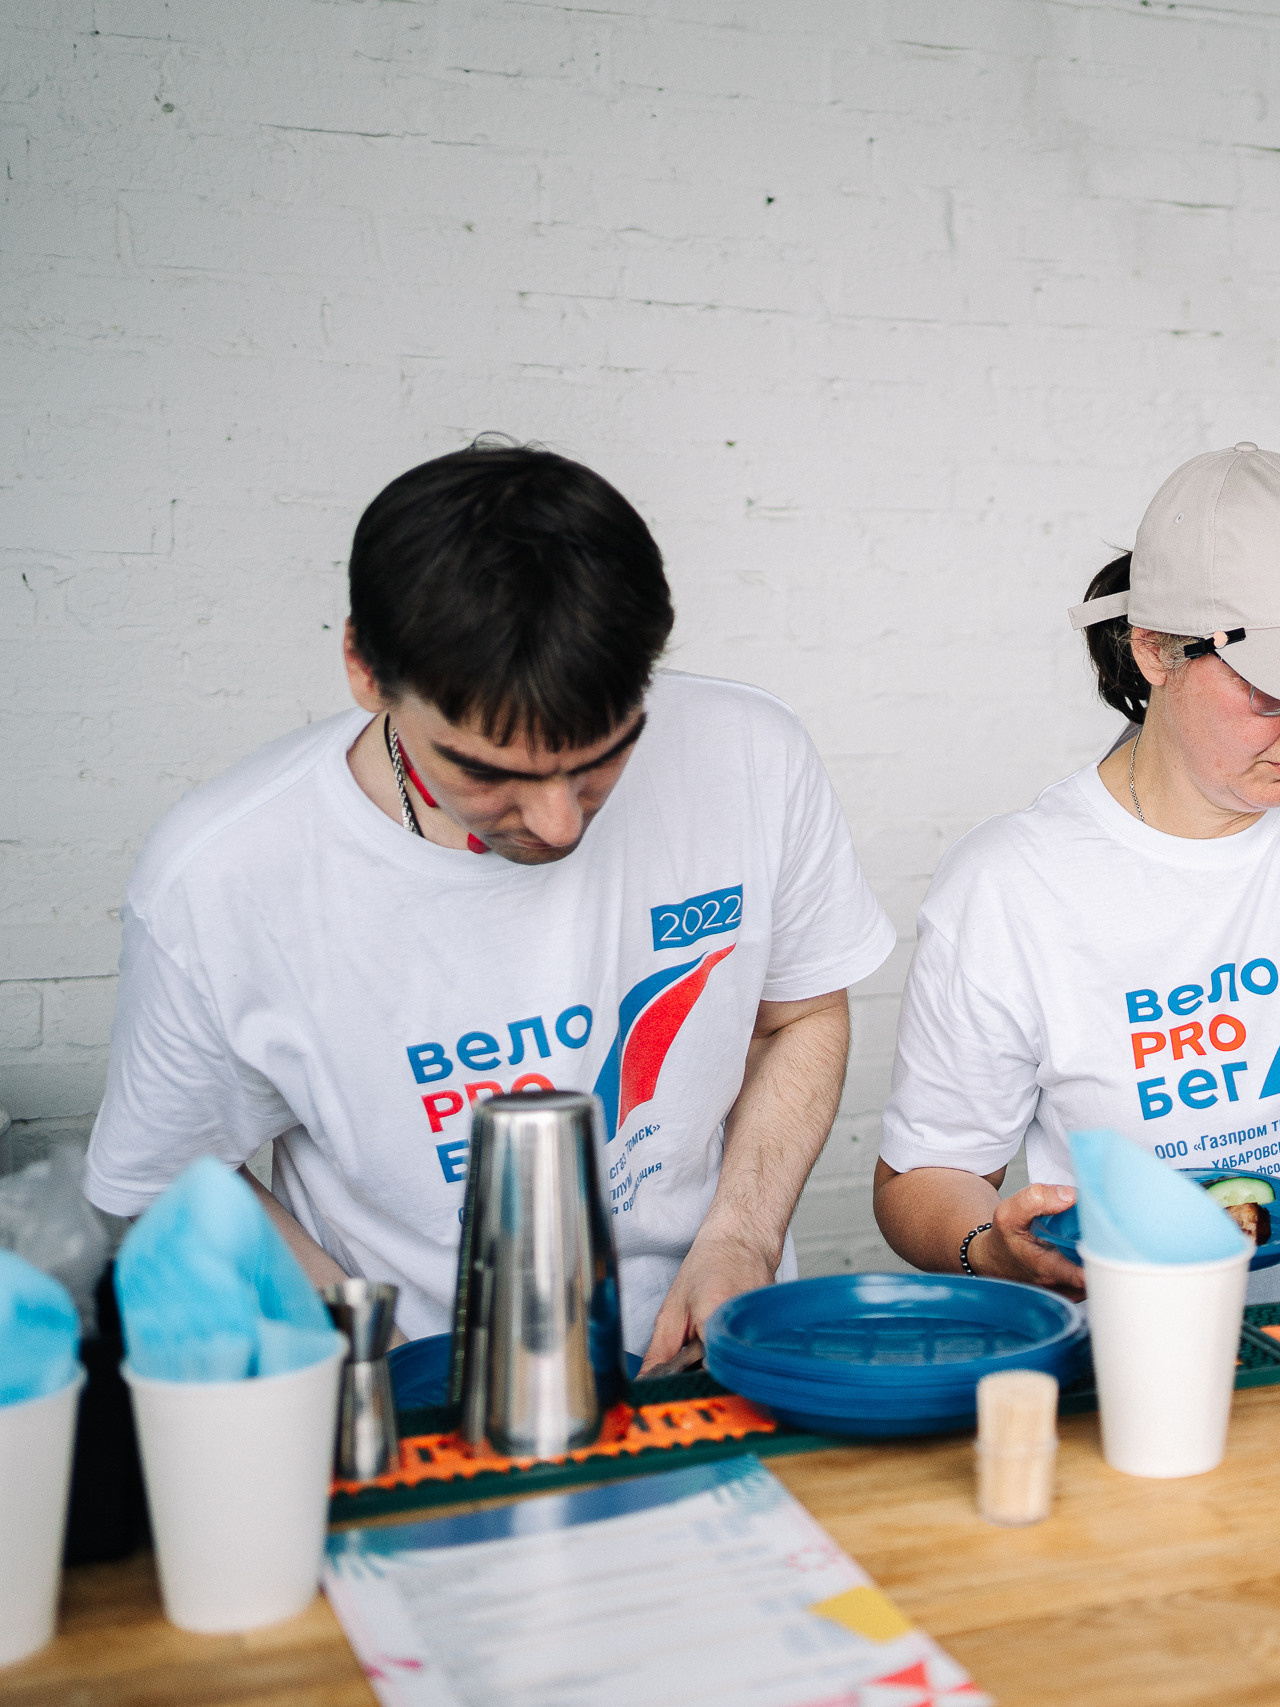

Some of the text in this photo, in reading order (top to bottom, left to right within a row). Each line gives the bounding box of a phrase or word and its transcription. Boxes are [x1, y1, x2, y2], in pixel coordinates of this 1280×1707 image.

[659, 894, 742, 942] 2022
[1131, 1013, 1247, 1070] PRO
[1194, 1124, 1267, 1151] «Газпром
